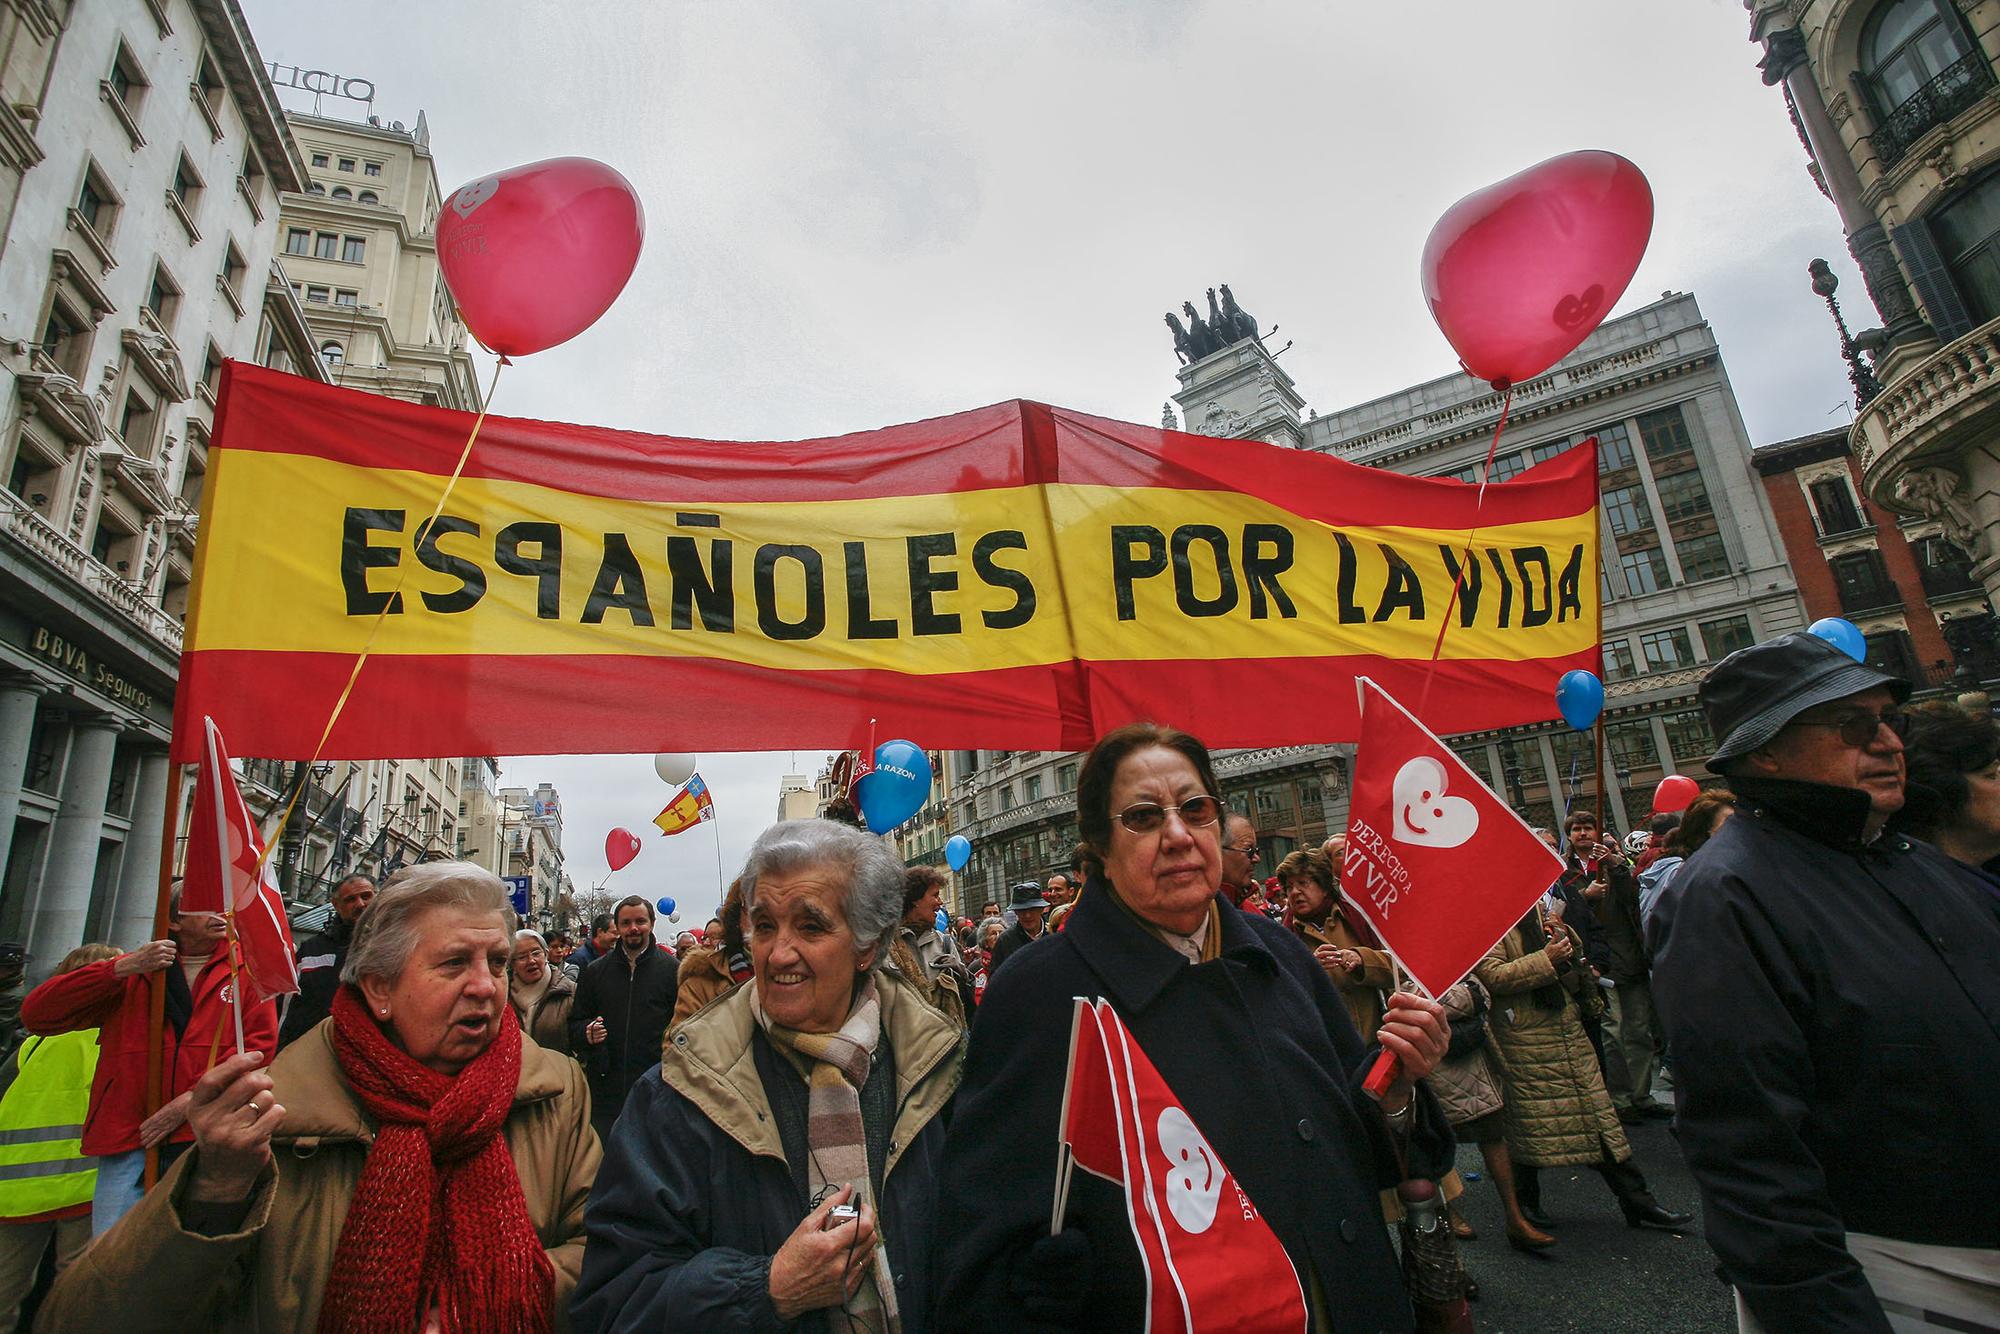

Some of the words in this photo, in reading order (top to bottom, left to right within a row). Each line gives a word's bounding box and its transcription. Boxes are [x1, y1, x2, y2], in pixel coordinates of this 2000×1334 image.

[1110, 523, 1298, 622] POR
[1331, 531, 1426, 625] LA
[1438, 543, 1584, 629] VIDA
[33, 626, 88, 674] BBVA
[96, 663, 153, 710] Seguros
[885, 765, 916, 780] RAZON
[1344, 839, 1399, 921] VIVIR
[1350, 818, 1409, 883] DERECHO
[1403, 882, 1412, 895] A
